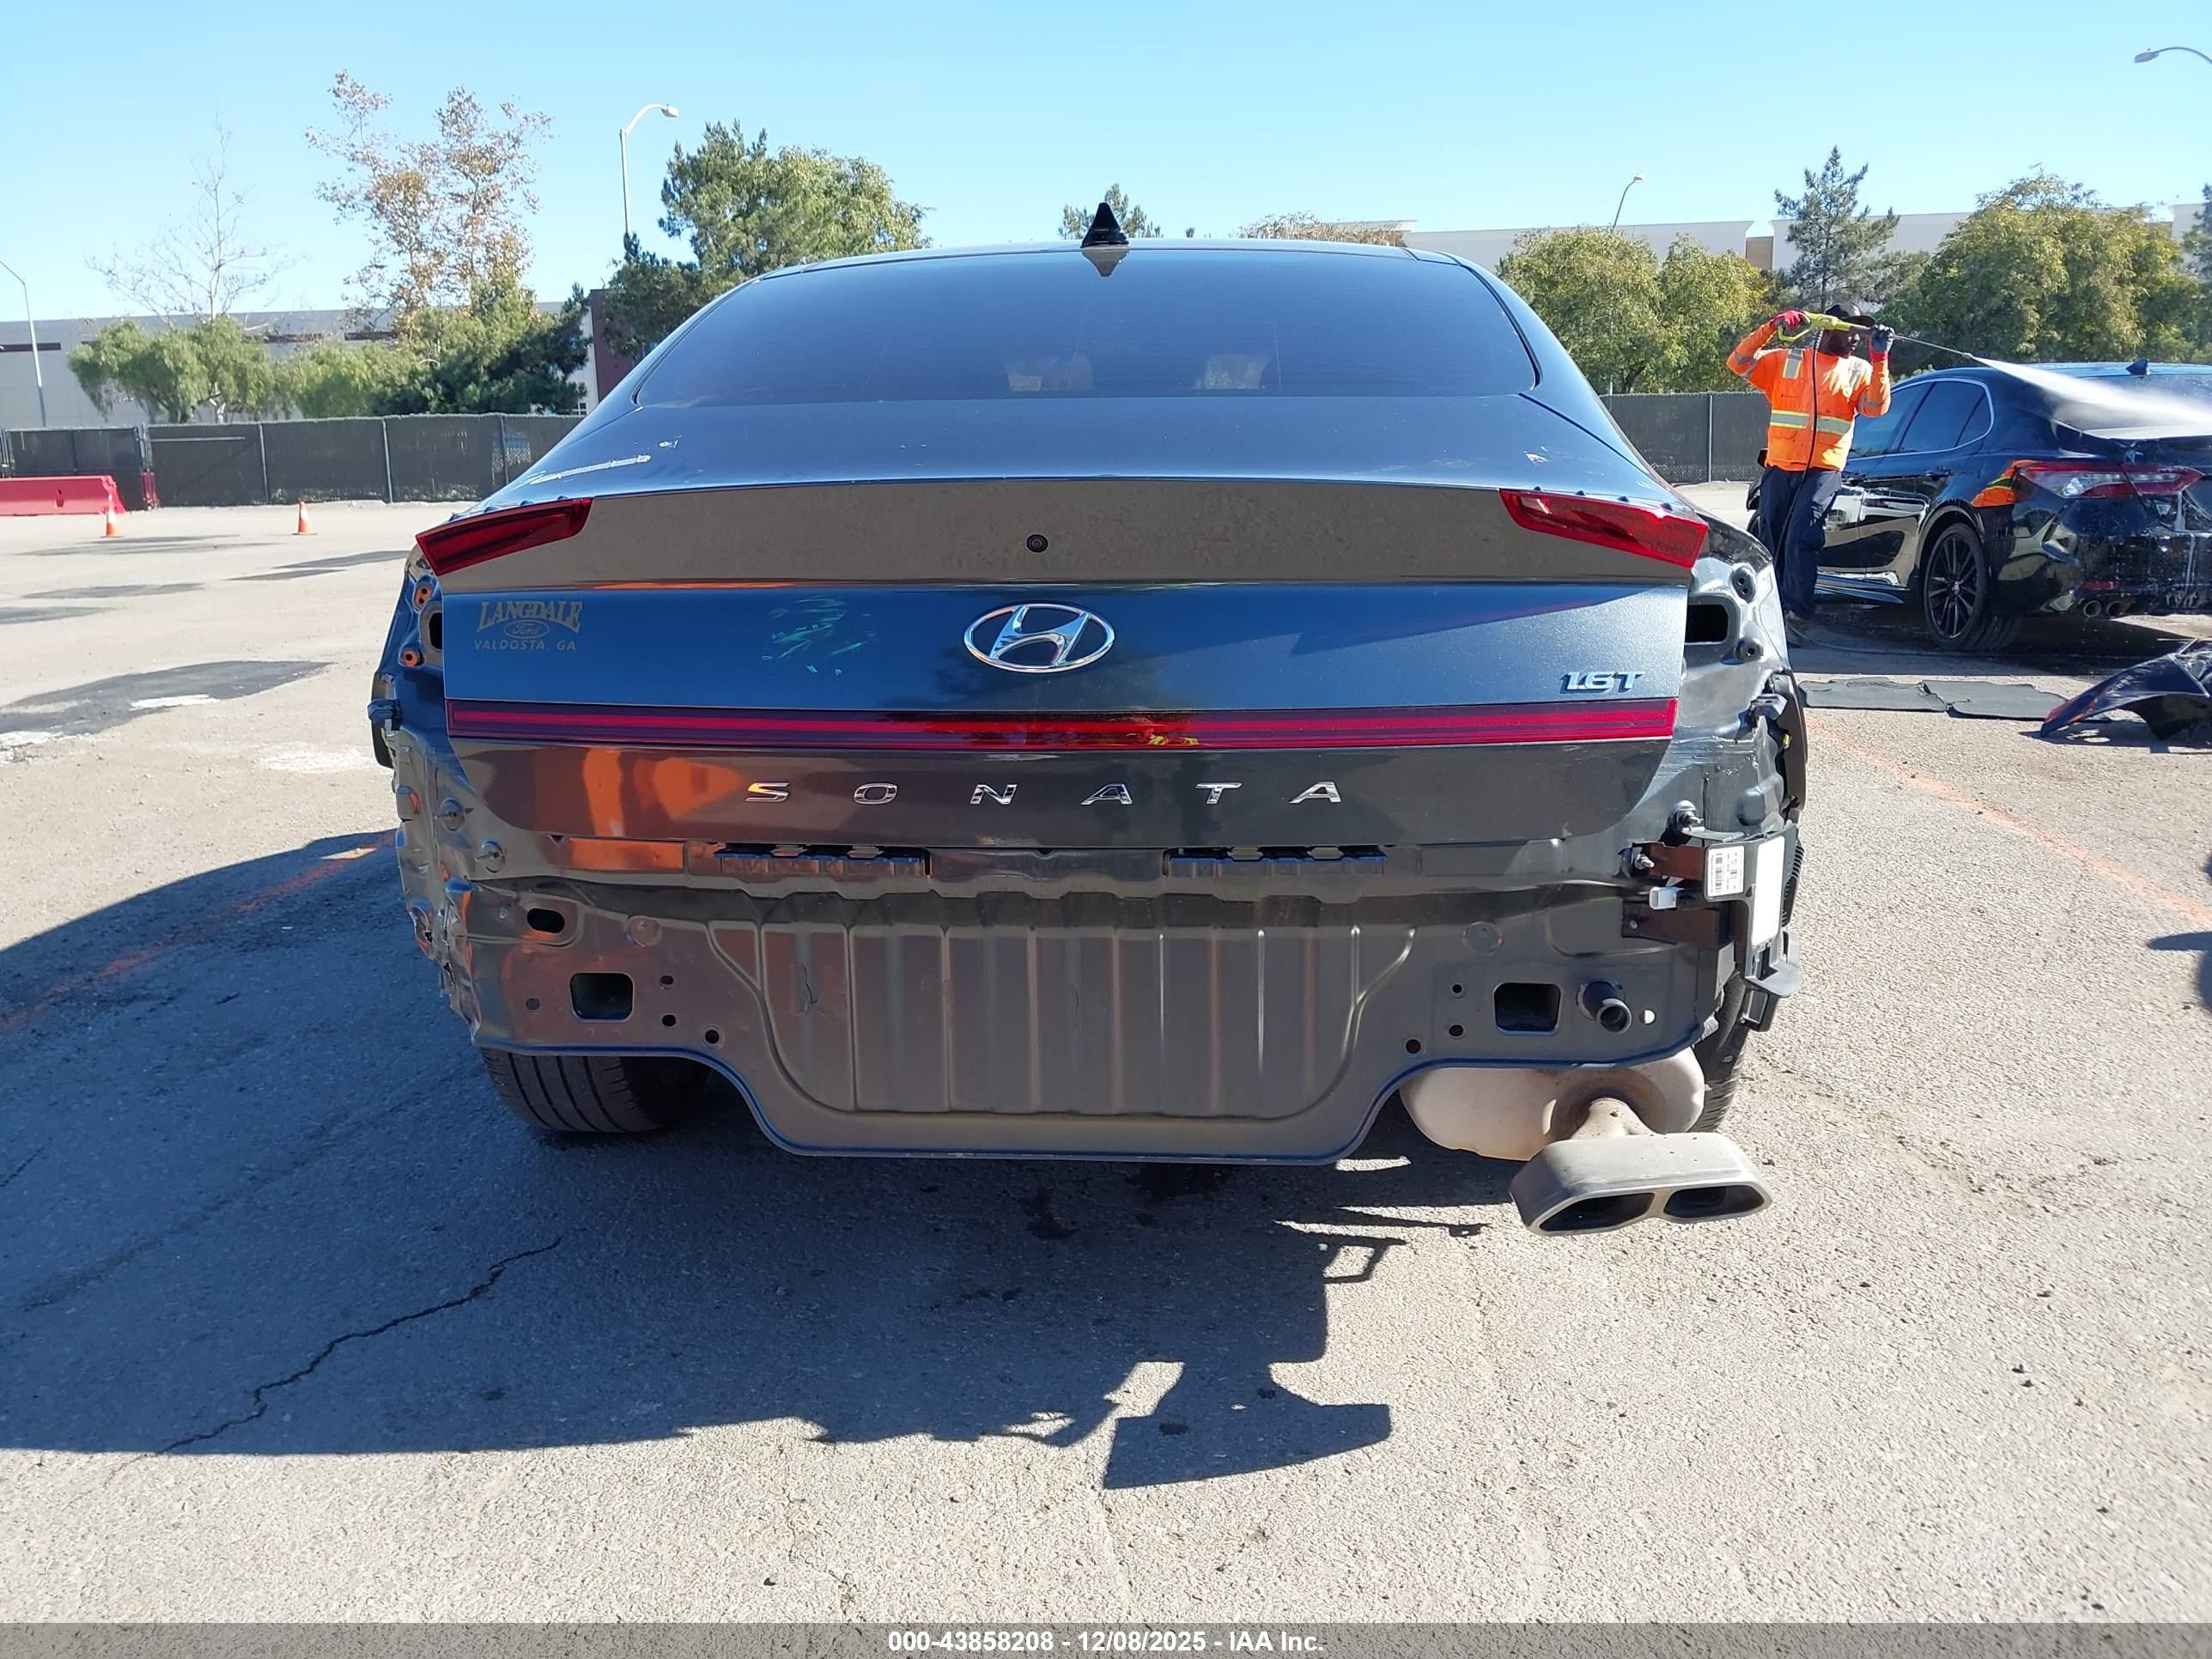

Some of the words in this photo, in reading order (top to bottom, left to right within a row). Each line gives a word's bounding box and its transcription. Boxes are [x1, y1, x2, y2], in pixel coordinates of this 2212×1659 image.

[476, 600, 583, 634] LANGDALE
[474, 639, 550, 652] VALDOSTA,
[556, 640, 576, 651] GA
[1559, 671, 1646, 694] 1.6T
[745, 781, 1342, 805] SONATA
